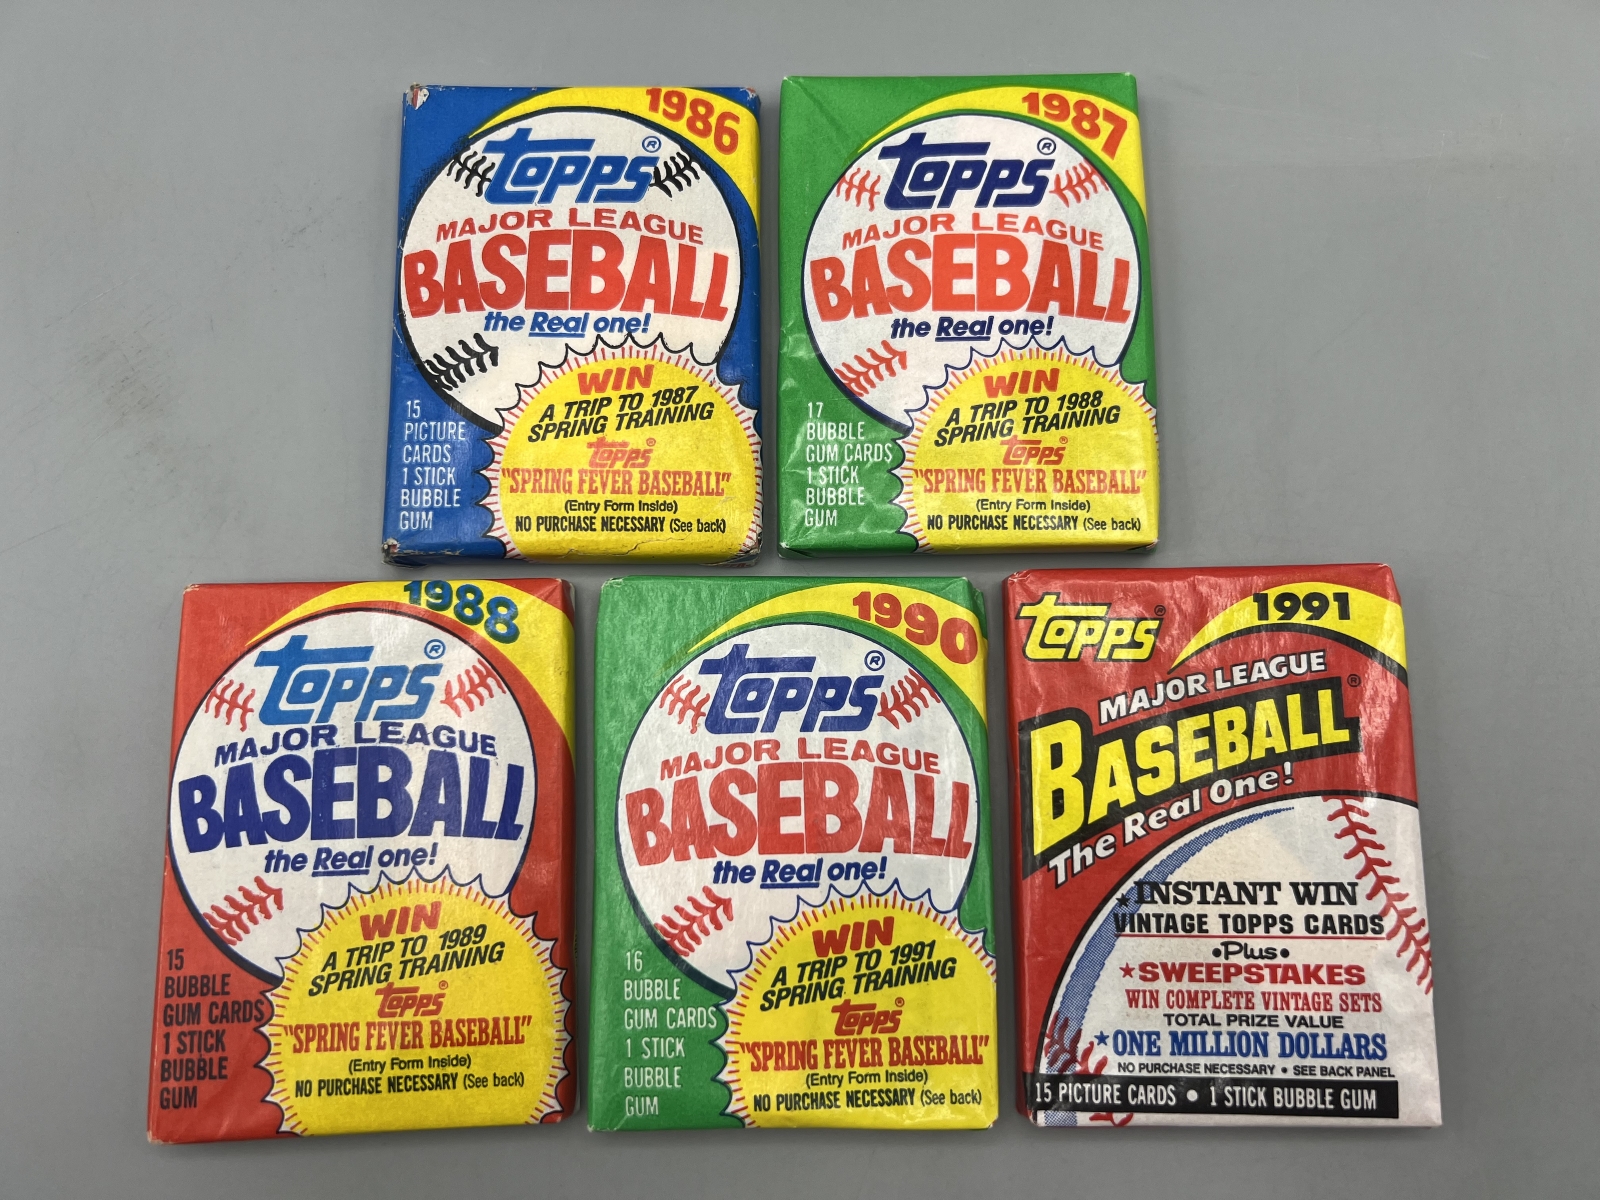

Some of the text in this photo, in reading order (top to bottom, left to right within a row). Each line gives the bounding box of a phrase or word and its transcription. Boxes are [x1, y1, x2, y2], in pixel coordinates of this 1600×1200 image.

[647, 88, 740, 155] 1986
[1022, 93, 1127, 159] 1987
[436, 209, 704, 245] MAJOR LEAGUE
[842, 213, 1103, 250] MAJOR LEAGUE
[403, 229, 729, 321] BASEBALL
[810, 234, 1131, 323] BASEBALL
[484, 312, 651, 338] the Real one!
[891, 316, 1053, 341] the Real one!
[578, 364, 654, 395] WIN
[984, 368, 1060, 398] WIN
[406, 400, 420, 418] 15
[808, 402, 824, 418] 17
[405, 422, 466, 440] PICTURE
[528, 402, 714, 442] SPRING TRAINING
[807, 422, 865, 440] BUBBLE
[934, 406, 1120, 447] SPRING TRAINING
[403, 445, 451, 462] CARDS
[806, 443, 892, 462] GUM CARDS
[502, 468, 731, 496] "SPRING FEVER BASEBALL"
[915, 469, 1146, 494] "SPRING FEVER BASEBALL"
[401, 488, 461, 507] BUBBLE
[565, 500, 678, 513] (Entry Form Inside)
[806, 487, 865, 505] BUBBLE
[976, 499, 1090, 512] (Entry Form Inside)
[400, 511, 433, 529] GUM
[516, 516, 726, 533] NO PURCHASE NECESSARY (See back)
[805, 508, 837, 526] GUM
[927, 515, 1141, 531] NO PURCHASE NECESSARY (See back)
[404, 580, 519, 643] 1988
[1251, 592, 1351, 621] 1991
[853, 591, 978, 664] 1990
[1099, 651, 1327, 725] MAJOR LEAGUE
[214, 722, 497, 766] MAJOR LEAGUE
[660, 737, 940, 779] MAJOR LEAGUE
[1030, 689, 1350, 856] BASEBALL
[178, 748, 526, 853] BASEBALL
[625, 762, 973, 867] BASEBALL
[1048, 761, 1295, 888] The Real One!
[265, 847, 437, 876] the Real one!
[713, 857, 887, 888] the Real one!
[1134, 880, 1358, 905] INSTANT WIN
[360, 901, 441, 940] WIN
[1113, 913, 1384, 934] VINTAGE TOPPS CARDS
[812, 916, 894, 958] WIN
[167, 949, 184, 971] 15
[308, 942, 505, 997] SPRING TRAINING
[626, 951, 643, 972] 16
[165, 973, 231, 998] BUBBLE
[760, 958, 957, 1011] SPRING TRAINING
[1138, 962, 1366, 985] SWEEPSTAKES
[624, 978, 681, 1001] BUBBLE
[1125, 989, 1382, 1012] WIN COMPLETE VINTAGE SETS
[163, 999, 264, 1027] GUM CARDS
[624, 1007, 717, 1029] GUM CARDS
[1163, 1014, 1344, 1029] TOTAL PRIZE VALUE
[284, 1015, 532, 1053] "SPRING FEVER BASEBALL"
[1113, 1030, 1387, 1060] ONE MILLION DOLLARS
[349, 1054, 472, 1074] (Entry Form Inside)
[741, 1035, 989, 1071] "SPRING FEVER BASEBALL"
[161, 1056, 228, 1082] BUBBLE
[624, 1067, 682, 1088] BUBBLE
[806, 1070, 928, 1089] (Entry Form Inside)
[1118, 1062, 1275, 1075] NO PURCHASE NECESSARY
[1293, 1065, 1395, 1078] SEE BACK PANEL
[296, 1072, 524, 1098] NO PURCHASE NECESSARY (See back)
[1035, 1083, 1176, 1105] 15 PICTURE CARDS
[1211, 1085, 1376, 1110] 1 STICK BUBBLE GUM
[160, 1086, 197, 1110] GUM
[625, 1096, 659, 1116] GUM
[754, 1089, 982, 1111] NO PURCHASE NECESSARY (See back)
